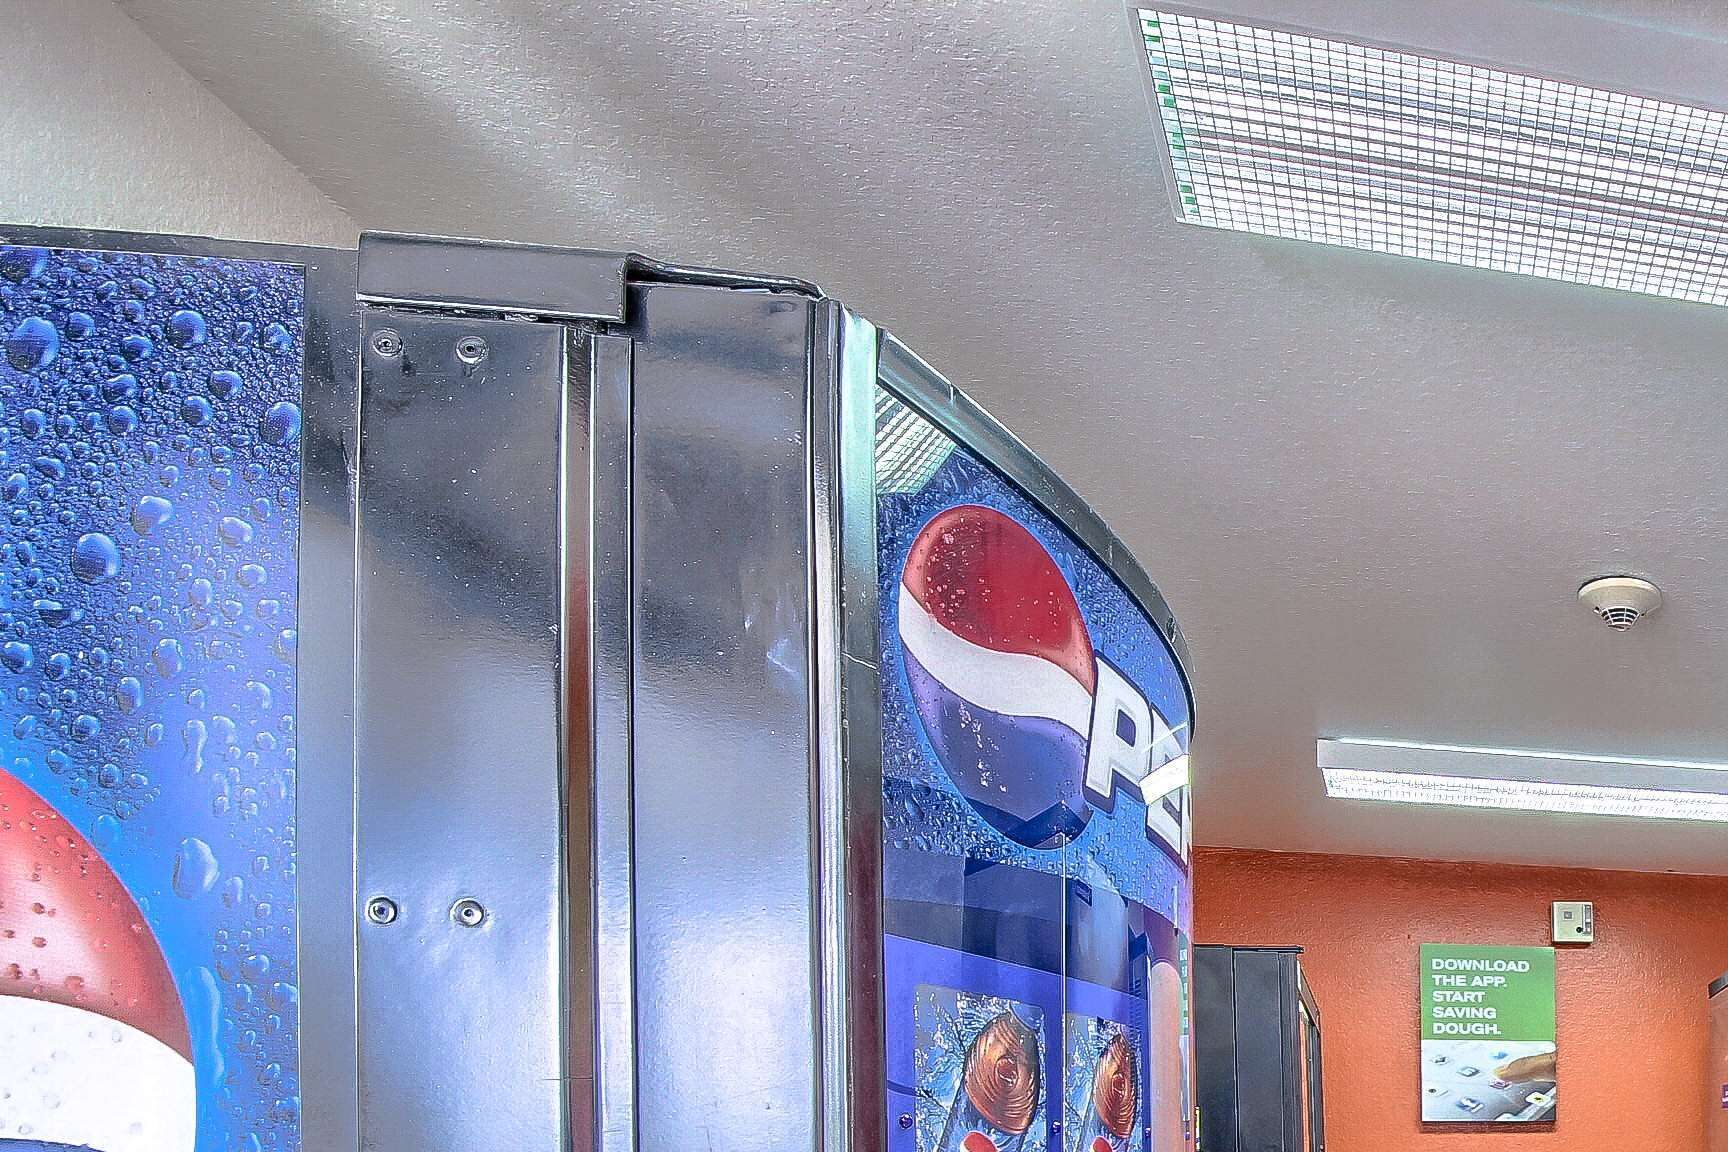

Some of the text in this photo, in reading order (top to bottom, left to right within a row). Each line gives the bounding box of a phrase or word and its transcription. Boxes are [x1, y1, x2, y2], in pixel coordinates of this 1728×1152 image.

[1431, 958, 1530, 973] DOWNLOAD
[1432, 974, 1508, 988] THE APP.
[1432, 991, 1486, 1003] START
[1432, 1006, 1497, 1019] SAVING
[1432, 1022, 1502, 1036] DOUGH.
